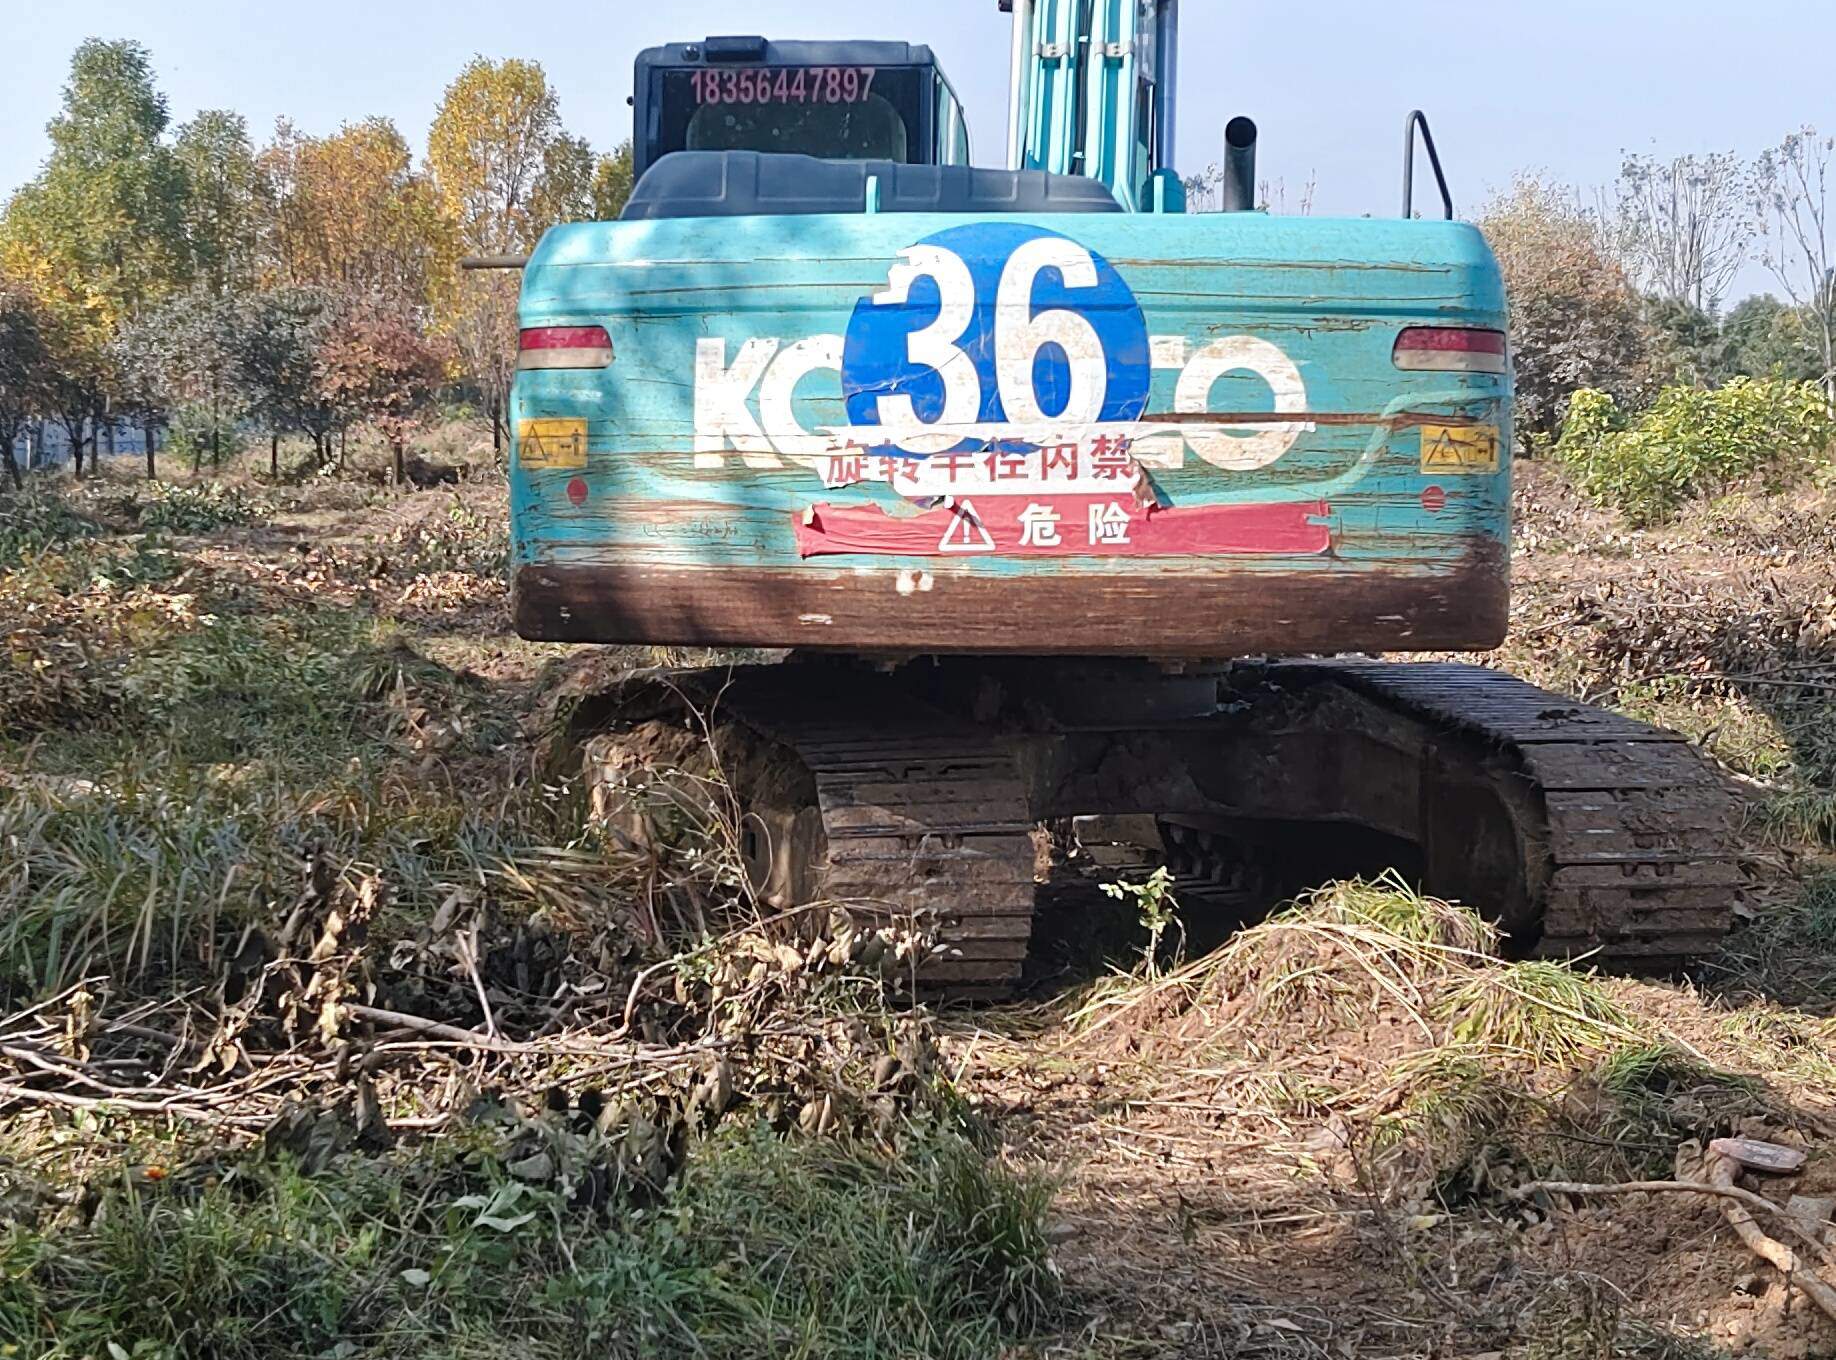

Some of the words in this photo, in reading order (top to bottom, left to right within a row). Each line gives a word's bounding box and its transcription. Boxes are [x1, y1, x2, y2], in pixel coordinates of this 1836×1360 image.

[690, 68, 876, 104] 18356447897
[873, 237, 1107, 452] 36
[1017, 502, 1132, 547] 危险
